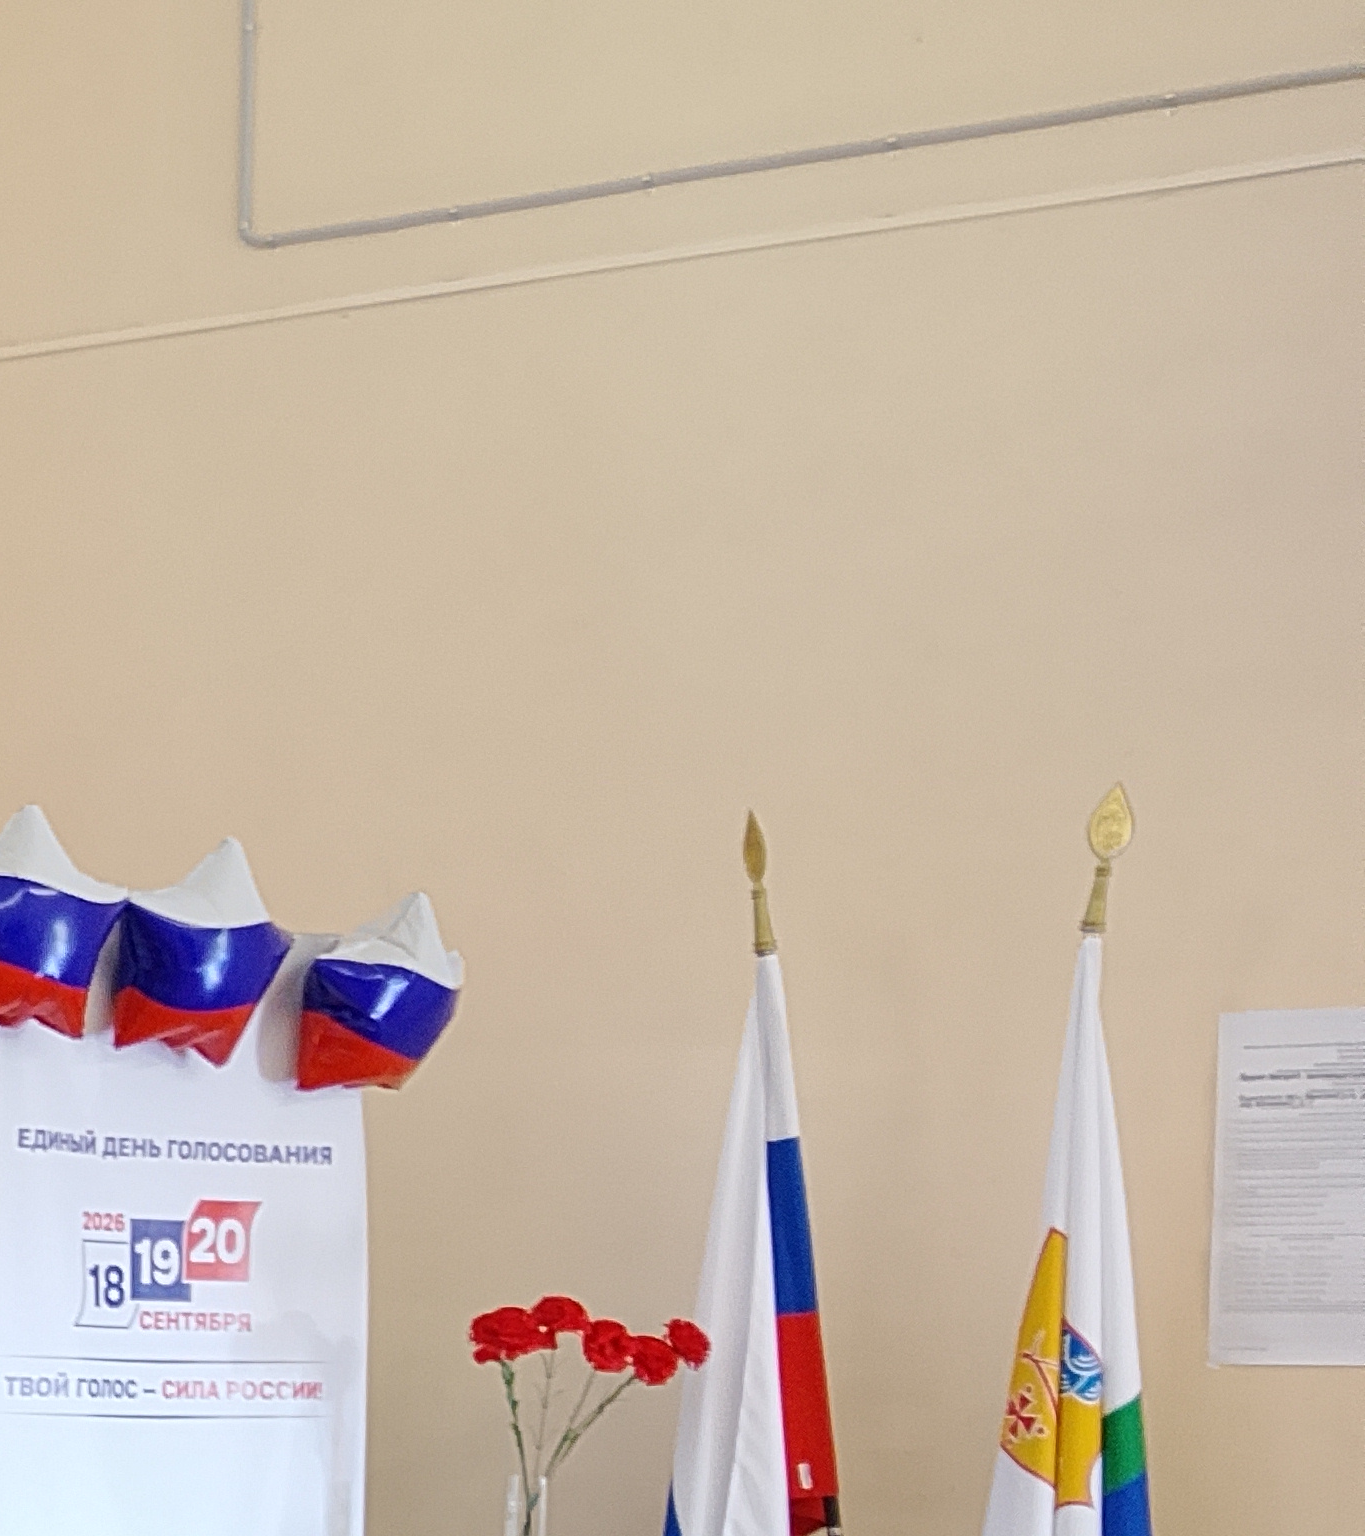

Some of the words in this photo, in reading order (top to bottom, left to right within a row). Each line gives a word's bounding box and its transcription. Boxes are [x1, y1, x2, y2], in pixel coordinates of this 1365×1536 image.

[18, 1128, 96, 1155] ЕДИНЫЙ
[102, 1137, 161, 1158] ДЕНЬ
[167, 1140, 333, 1165] ГОЛОСОВАНИЯ
[82, 1210, 125, 1232] 2026
[88, 1264, 125, 1308] 18
[134, 1238, 180, 1286] 19
[189, 1217, 246, 1264] 20
[139, 1310, 252, 1332] СЕНТЯБРЯ
[4, 1372, 70, 1397] ТВОЙ
[76, 1377, 137, 1398] ГОЛОС
[161, 1379, 219, 1400] СИЛА
[226, 1380, 323, 1401] РОССИИ!
